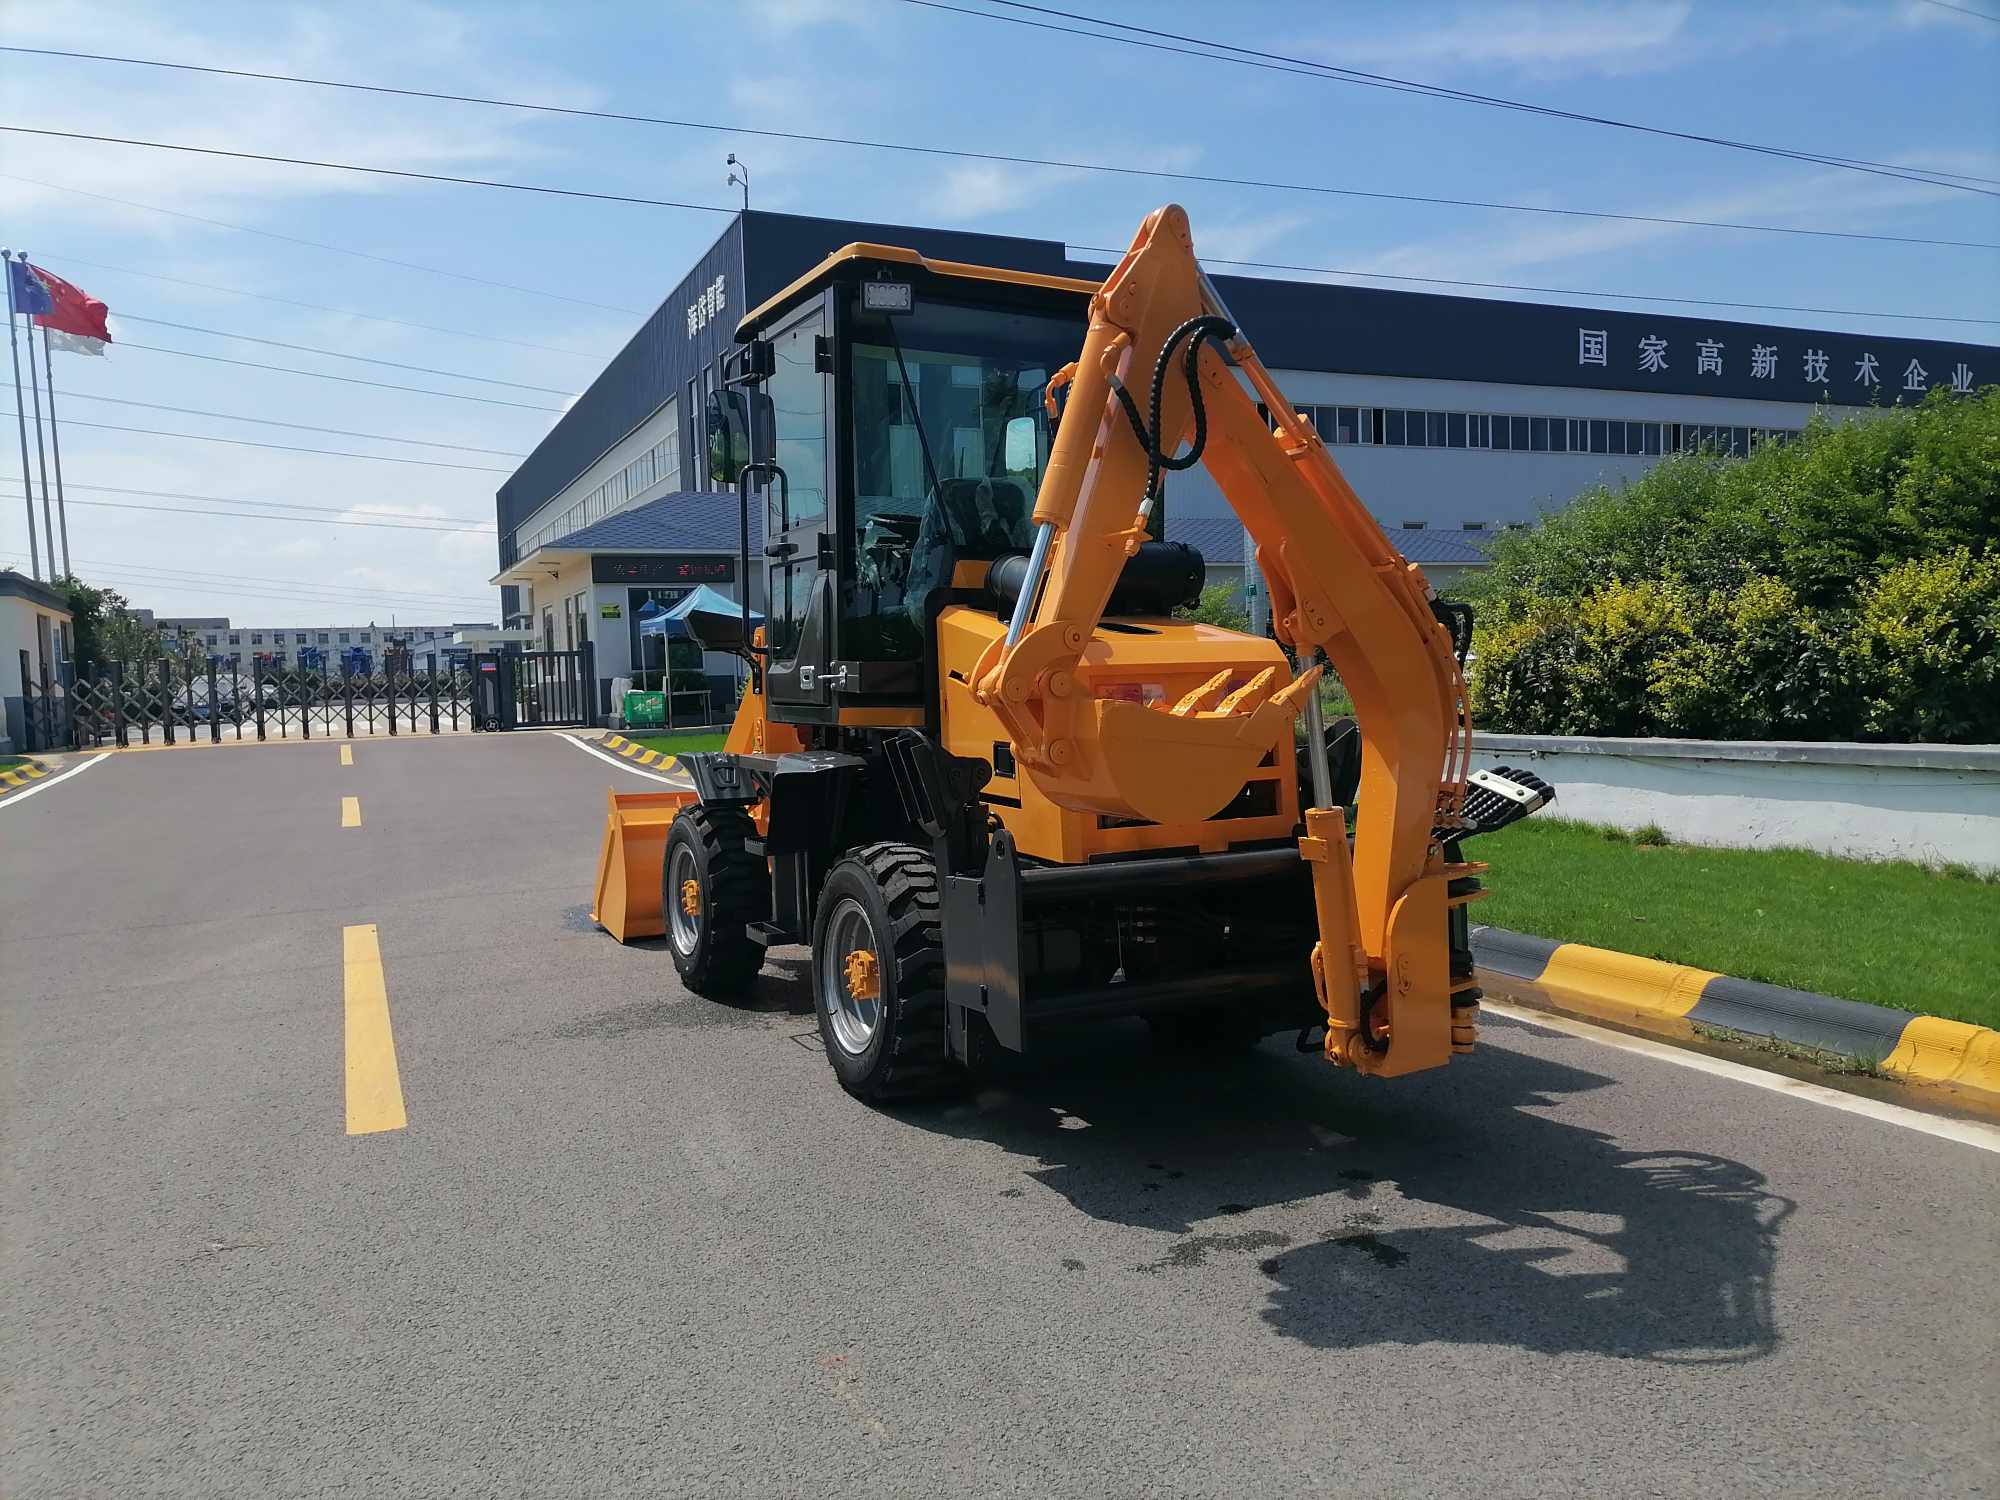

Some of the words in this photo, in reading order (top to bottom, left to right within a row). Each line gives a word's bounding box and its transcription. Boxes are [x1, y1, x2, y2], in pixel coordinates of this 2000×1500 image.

[1578, 329, 1974, 393] 国家高新技术企业
